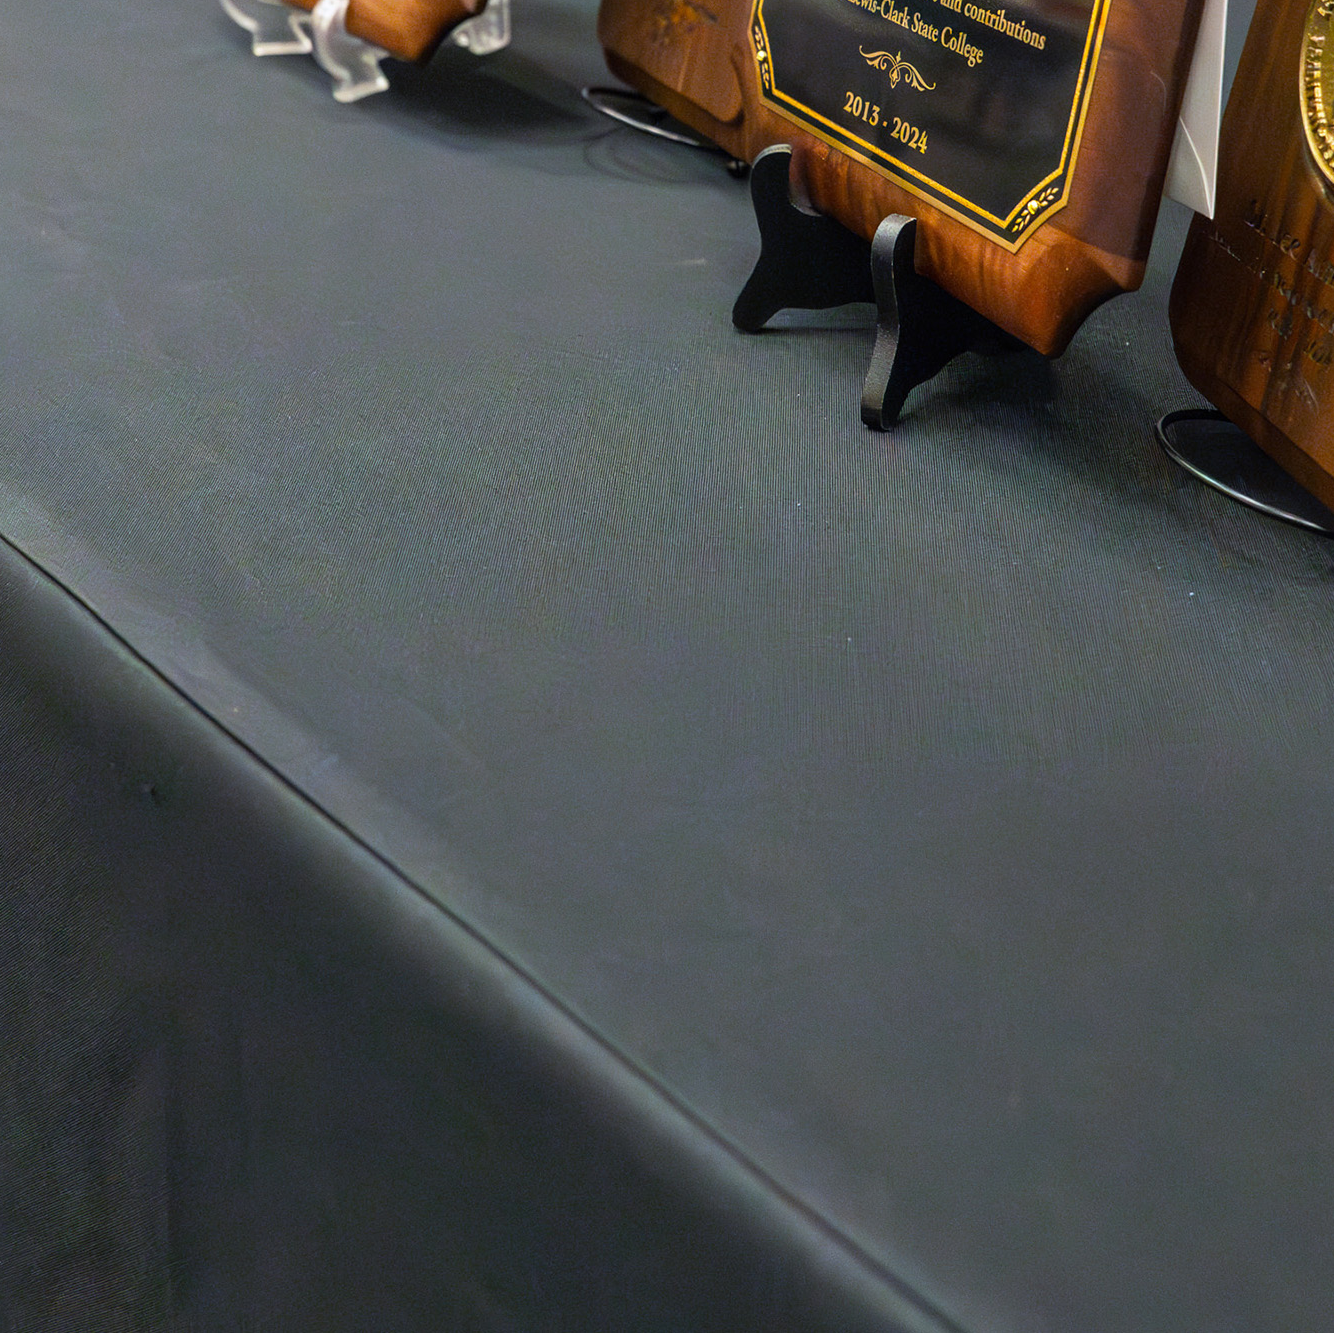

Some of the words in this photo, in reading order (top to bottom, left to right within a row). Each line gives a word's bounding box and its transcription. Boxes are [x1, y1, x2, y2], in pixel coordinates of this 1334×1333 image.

[911, 12, 939, 43] State
[941, 26, 985, 67] College
[963, 2, 1047, 50] contributions
[843, 91, 880, 126] 2013
[890, 116, 929, 154] 2024
